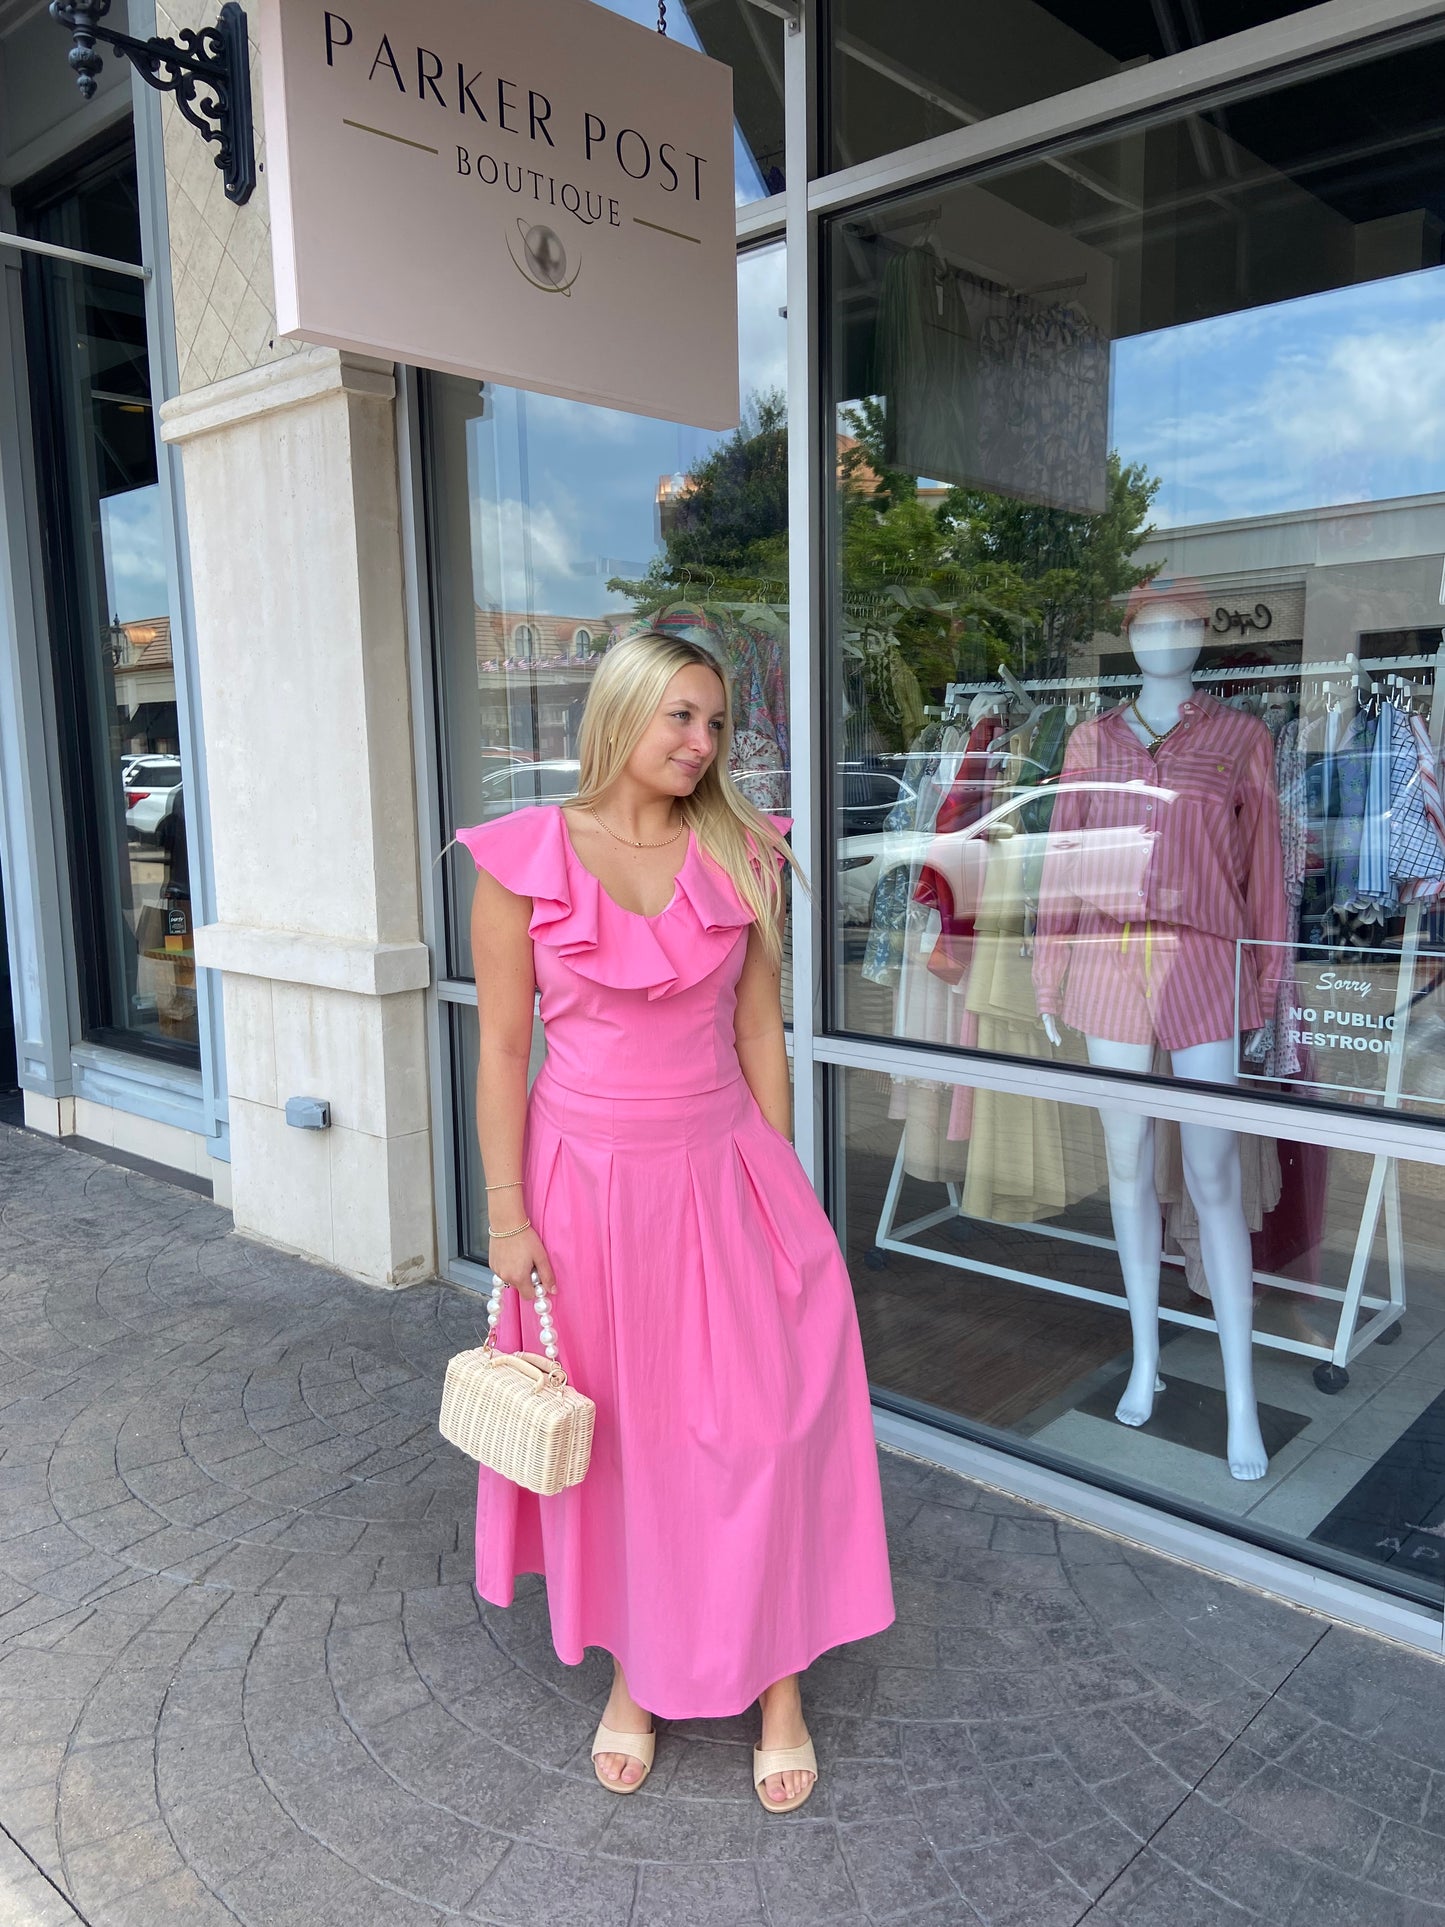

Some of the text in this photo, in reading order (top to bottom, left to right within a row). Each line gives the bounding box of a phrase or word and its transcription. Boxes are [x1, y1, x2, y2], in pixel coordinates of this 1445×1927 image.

[324, 11, 707, 201] PARKER POST
[456, 145, 621, 227] BOUTIQUE
[1316, 972, 1372, 997] Sorry
[1289, 1007, 1399, 1030] NO PUBLIC
[1288, 1031, 1400, 1054] RESTROOM
